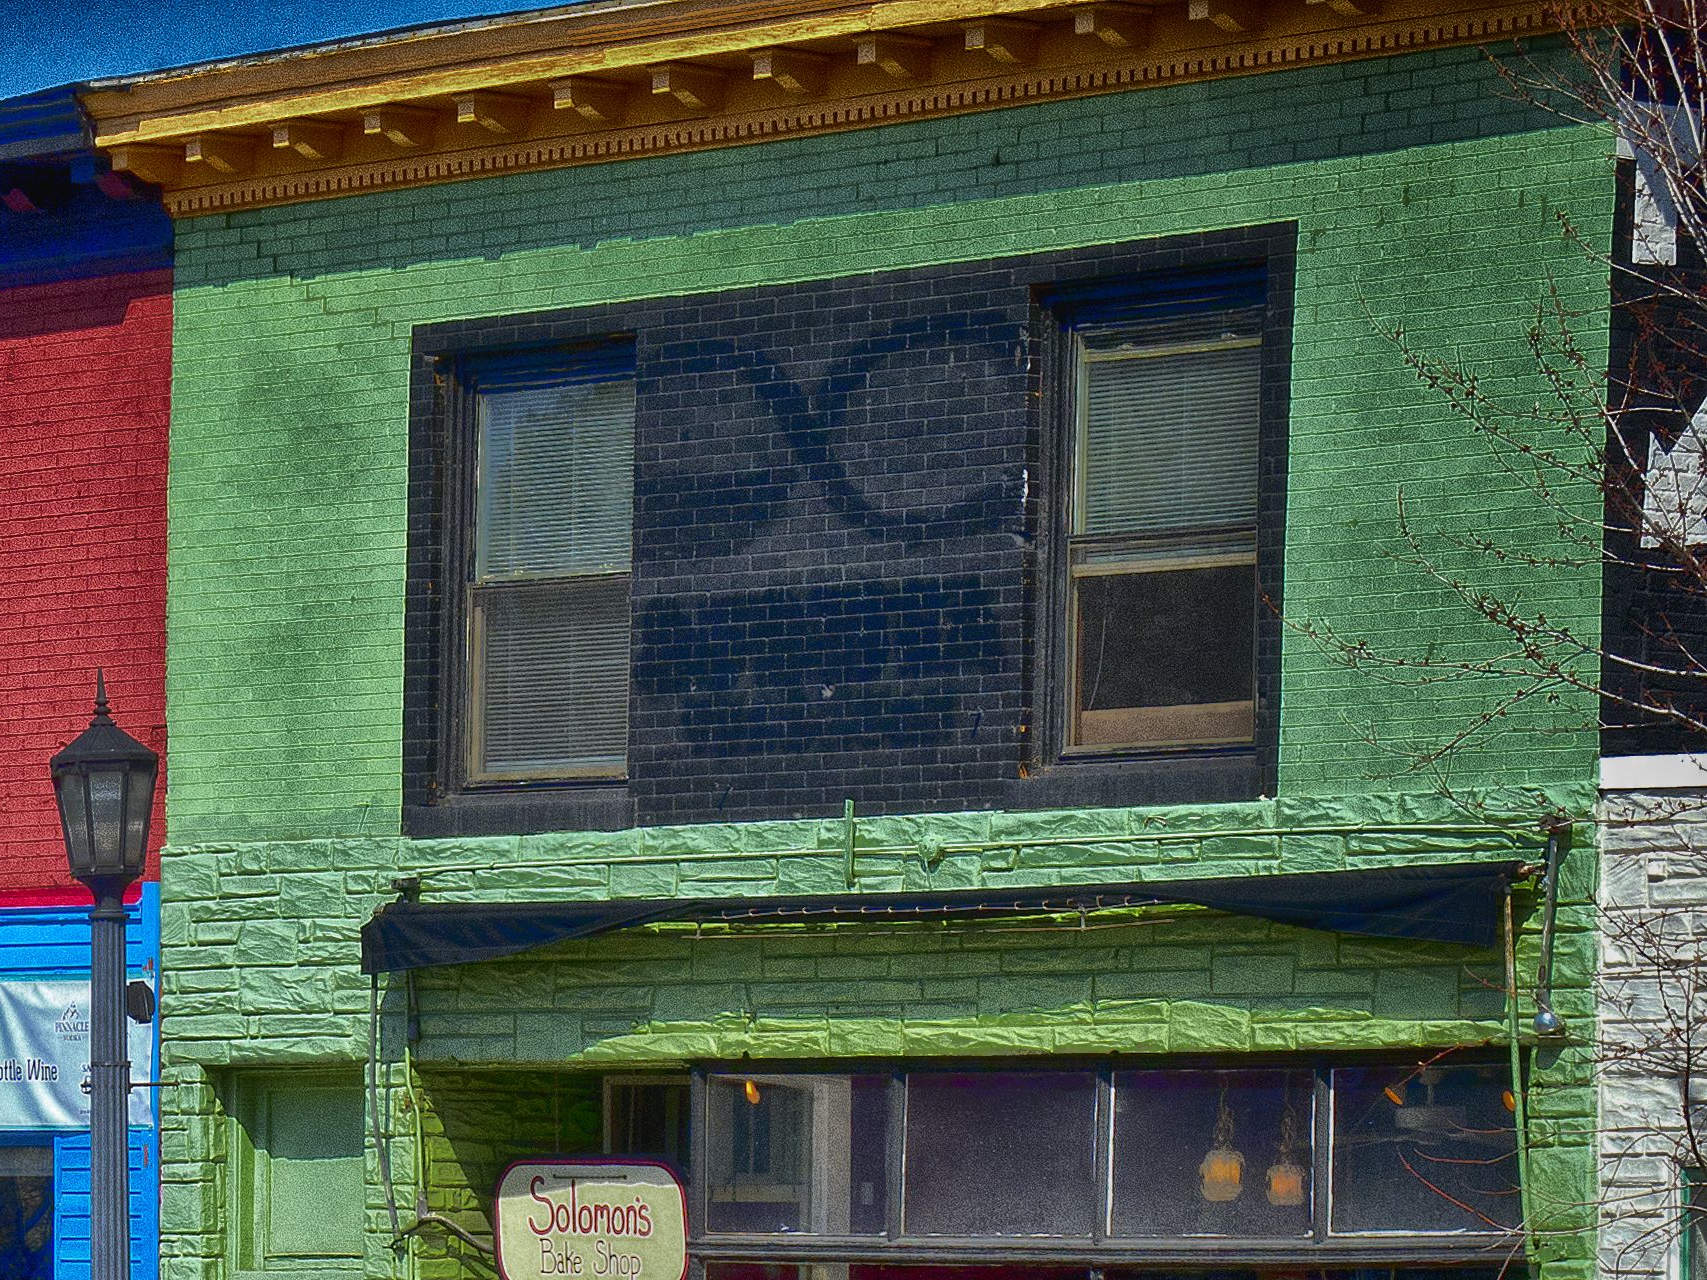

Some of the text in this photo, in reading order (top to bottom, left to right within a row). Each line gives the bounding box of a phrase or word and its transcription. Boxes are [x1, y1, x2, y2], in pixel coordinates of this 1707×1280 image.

[27, 1059, 58, 1081] Wine
[528, 1175, 652, 1238] Solomon's
[539, 1238, 642, 1280] Bake Shop
